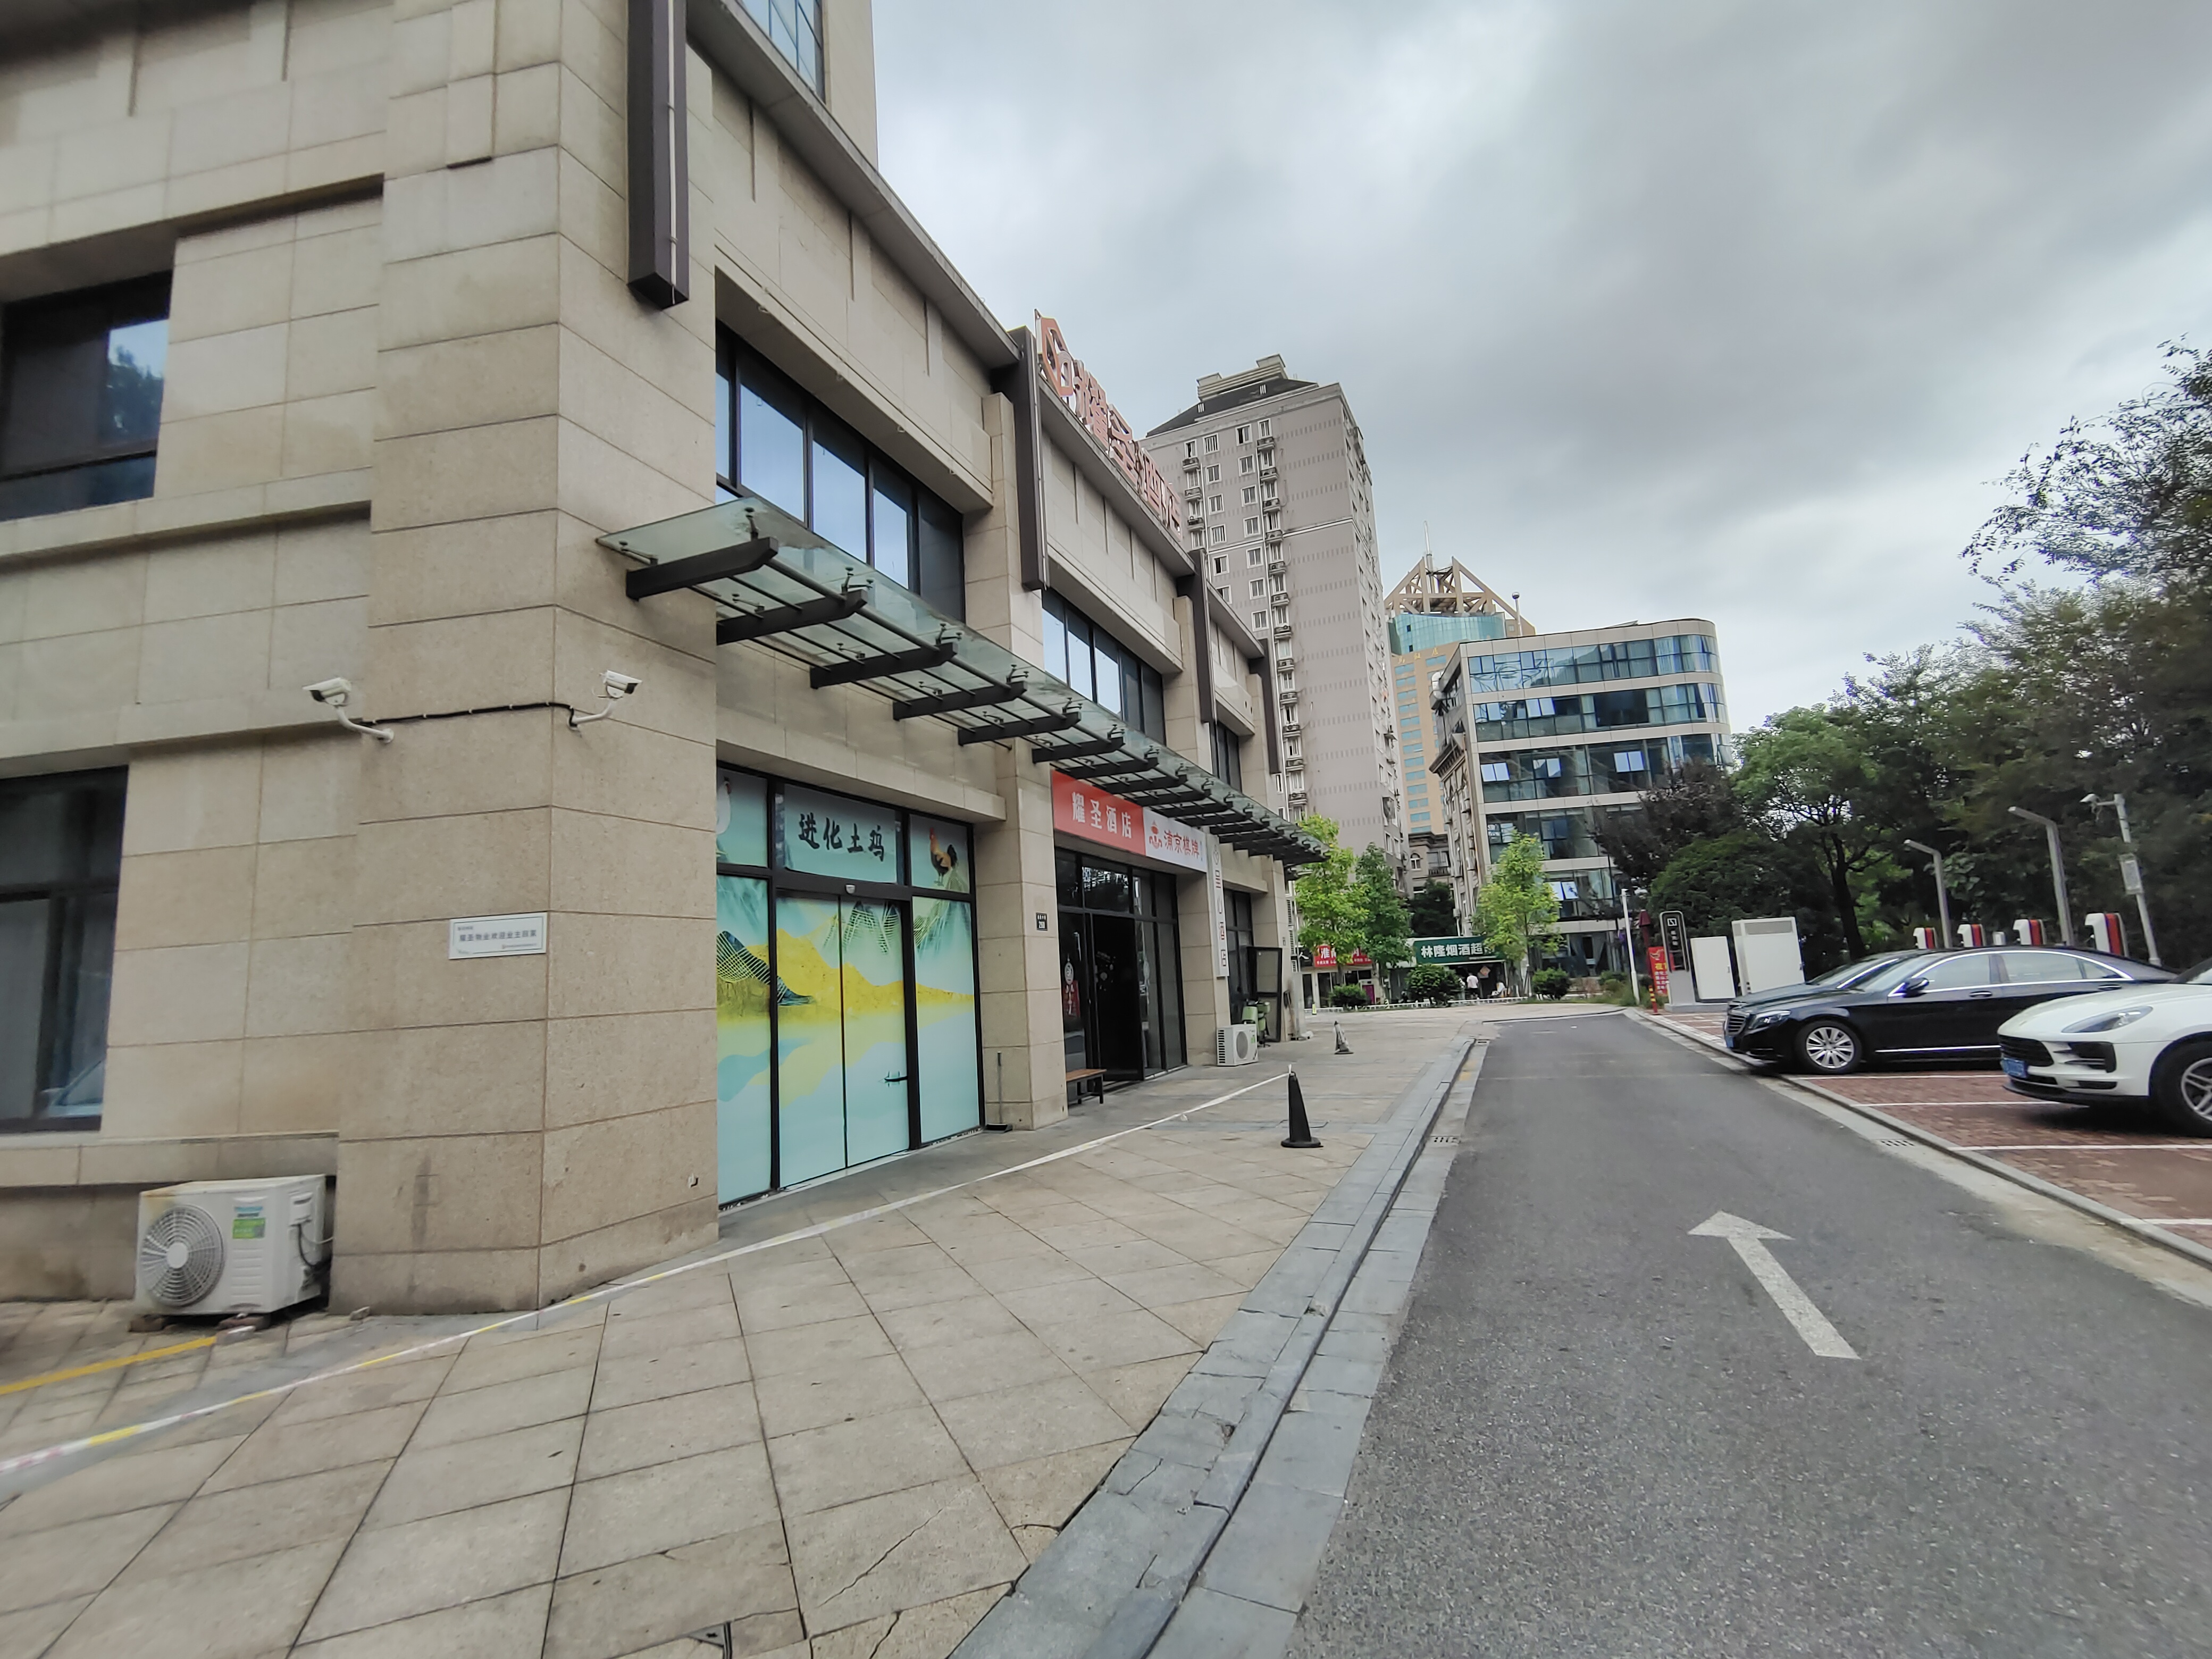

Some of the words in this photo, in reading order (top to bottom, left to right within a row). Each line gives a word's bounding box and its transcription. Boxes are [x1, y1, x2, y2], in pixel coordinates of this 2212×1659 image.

[1074, 359, 1183, 542] 耀圣酒店
[798, 812, 885, 862] 进化土鸡
[1072, 791, 1132, 839] 耀圣酒店
